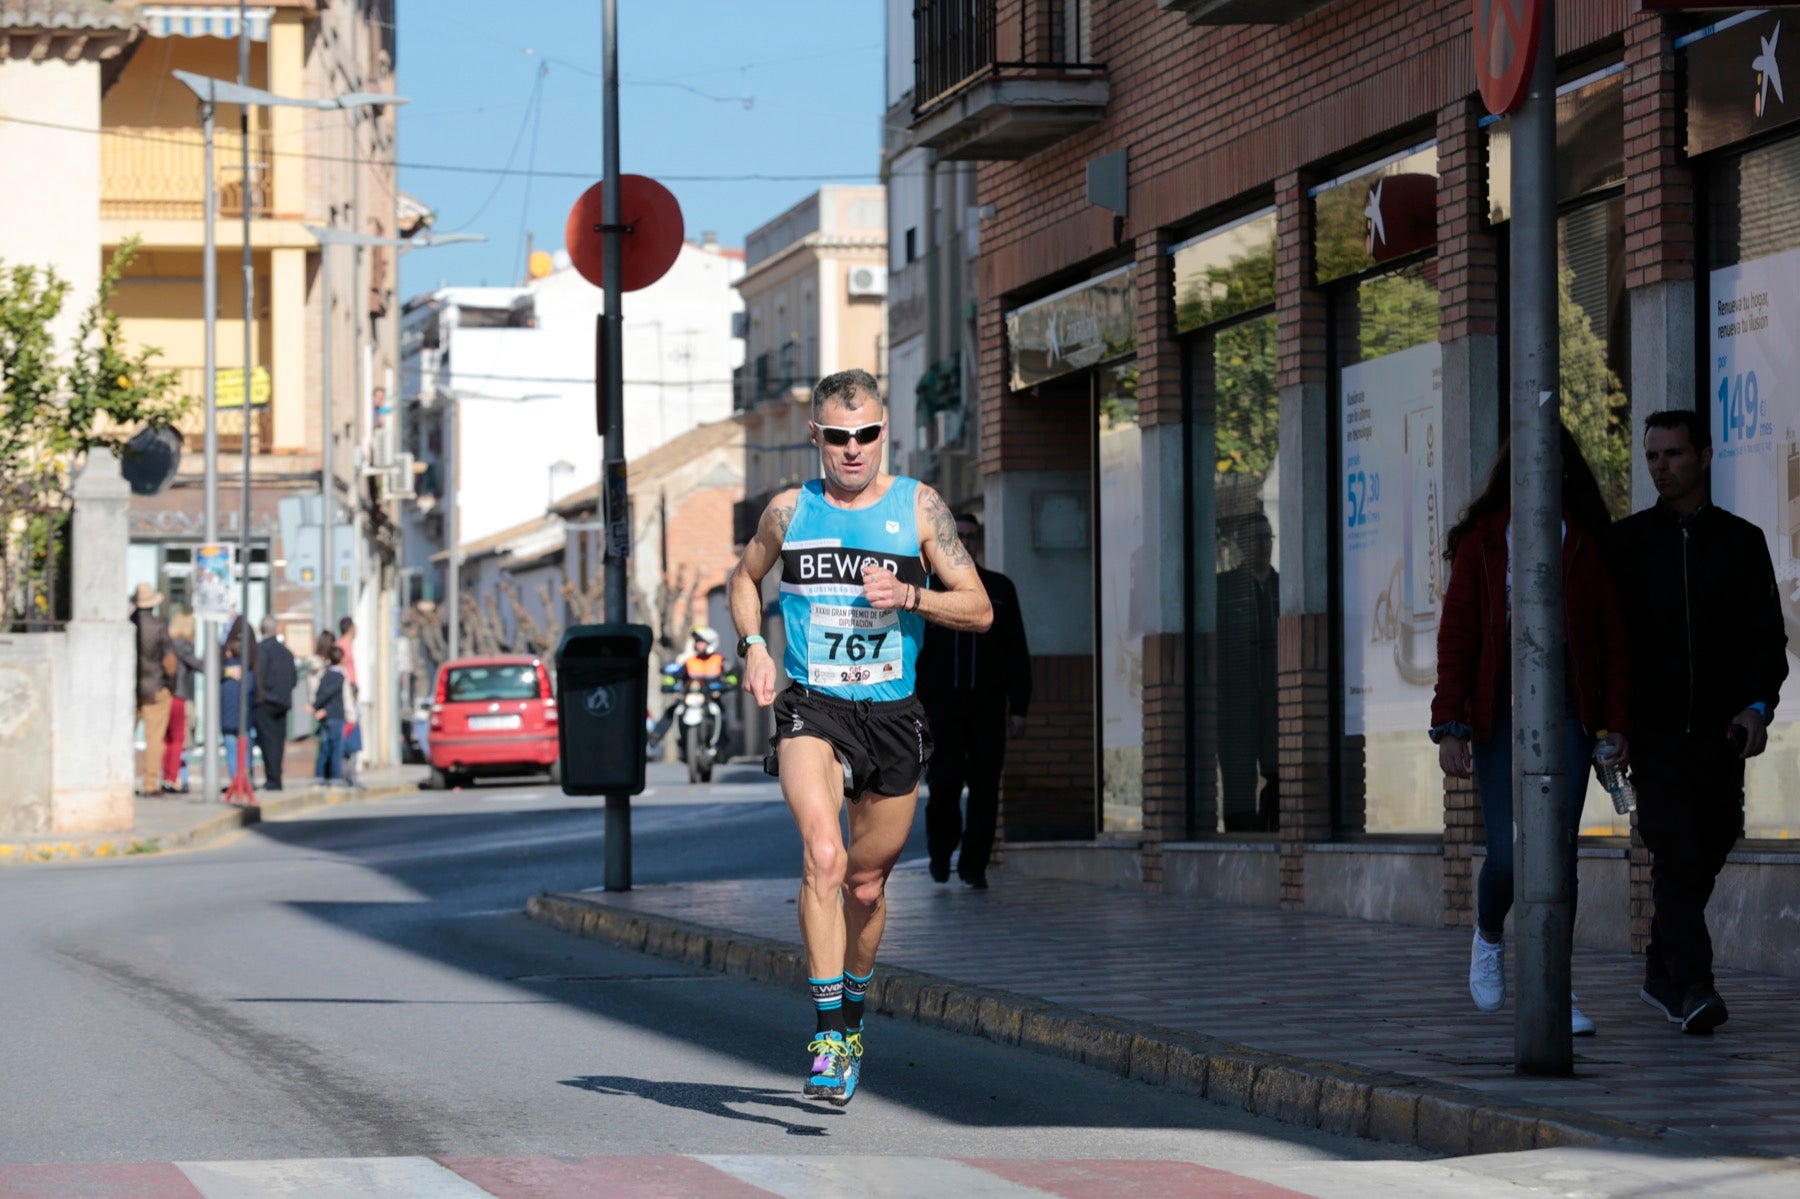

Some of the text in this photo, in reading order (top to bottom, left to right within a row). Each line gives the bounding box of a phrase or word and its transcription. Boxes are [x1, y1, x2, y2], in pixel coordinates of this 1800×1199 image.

[1717, 299, 1742, 316] Renueva
[1743, 296, 1750, 311] tu
[1717, 322, 1741, 339] renueva
[1742, 318, 1749, 333] tu
[1718, 370, 1758, 443] 149
[831, 608, 847, 617] GRAN
[848, 609, 869, 618] PREMIO
[870, 610, 878, 619] DE
[824, 632, 887, 662] 767
